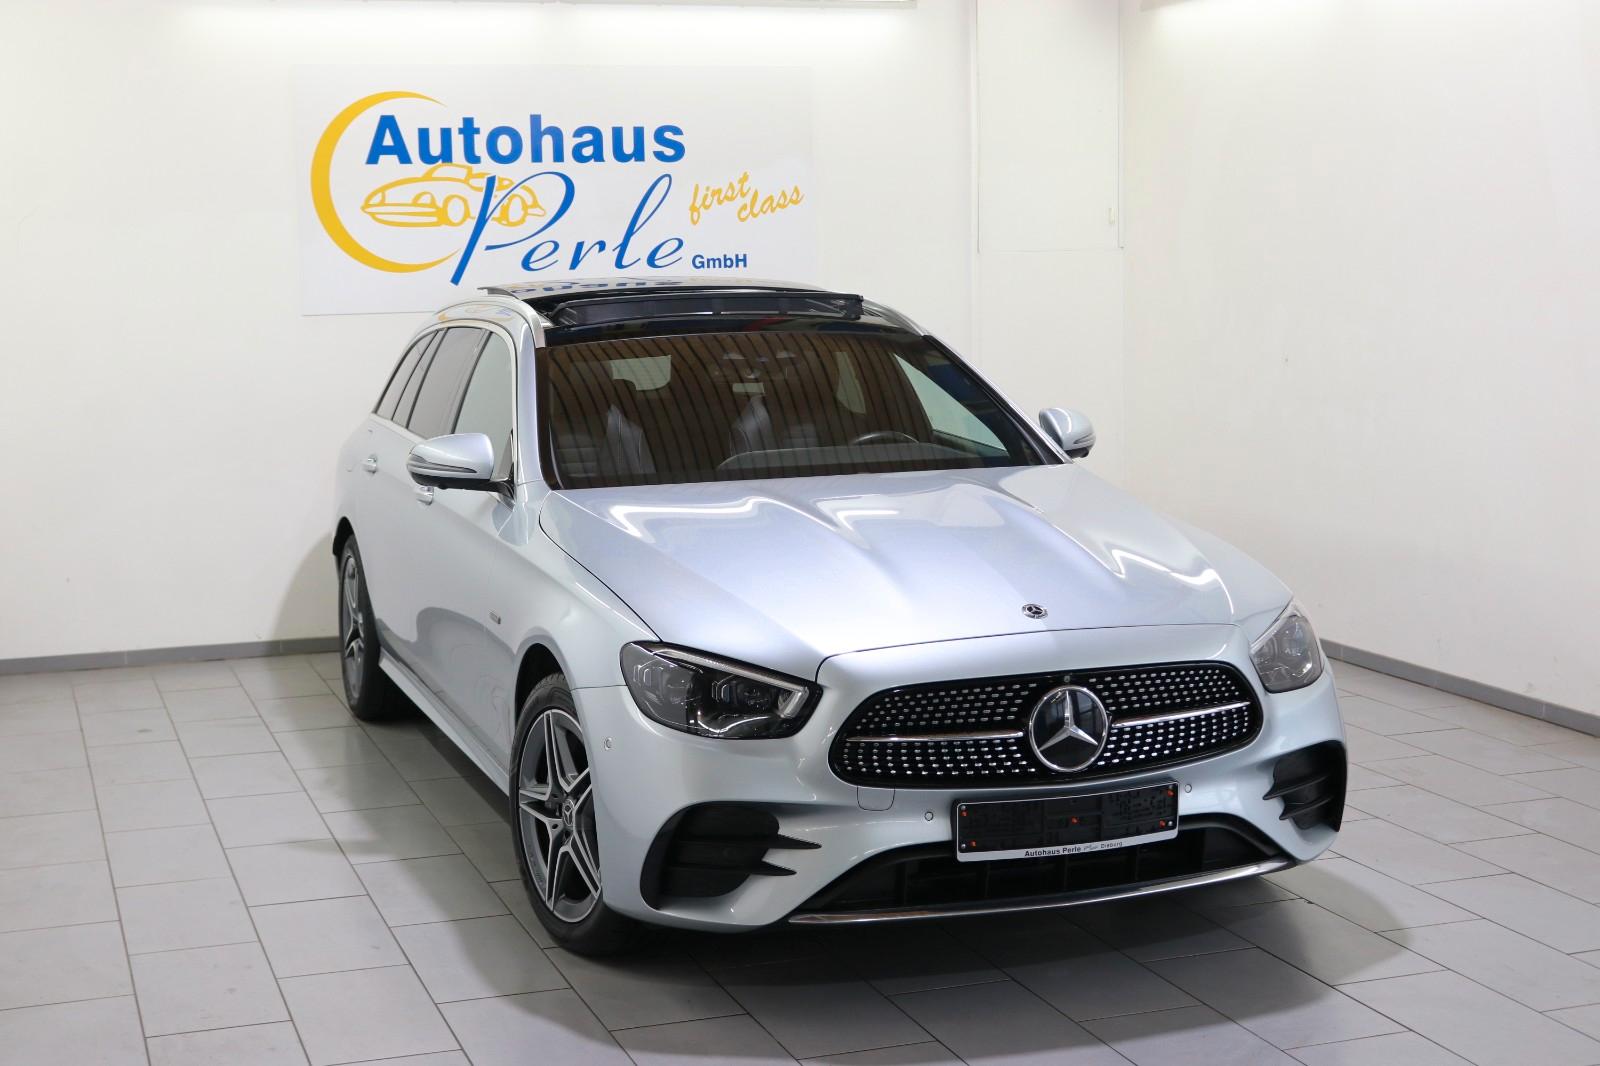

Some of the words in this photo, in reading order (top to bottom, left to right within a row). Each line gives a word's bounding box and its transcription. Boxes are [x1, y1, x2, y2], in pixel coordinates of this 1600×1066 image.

[366, 114, 686, 166] Autohaus
[689, 172, 751, 226] first
[736, 185, 805, 224] class
[450, 171, 684, 286] Perle
[691, 254, 748, 270] GmbH
[1024, 849, 1061, 857] Autohaus
[1062, 846, 1082, 854] Perle
